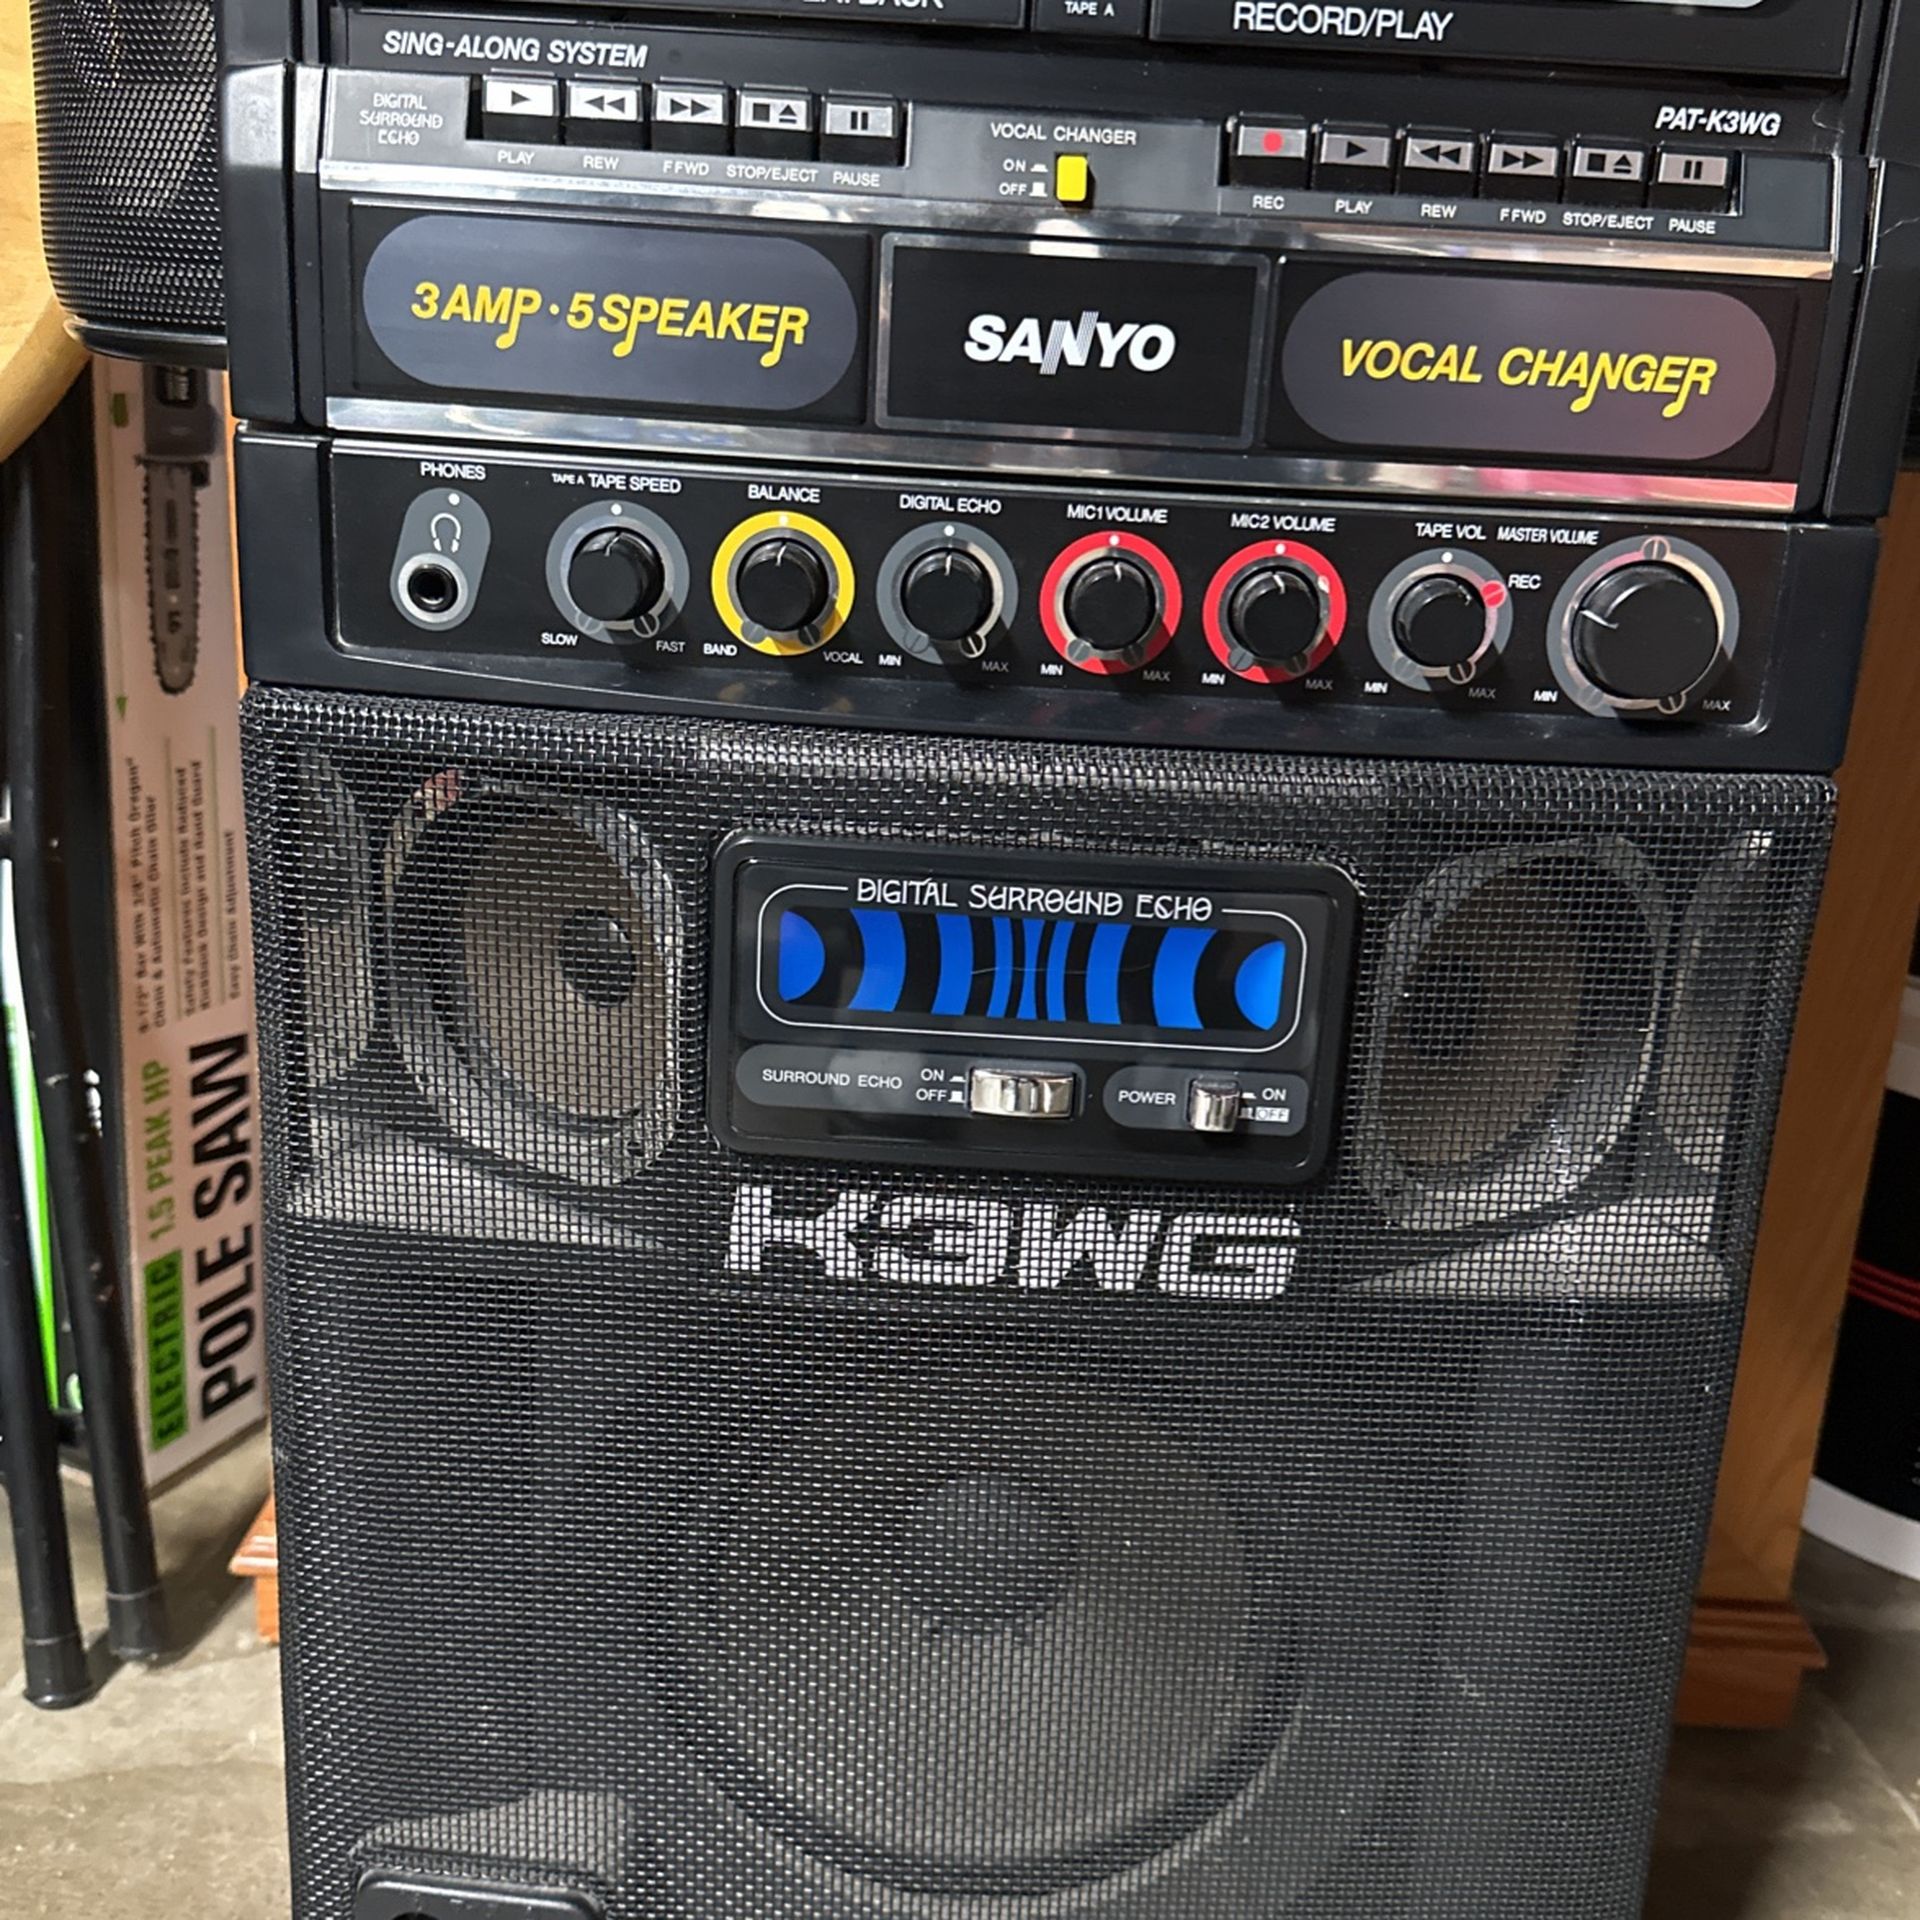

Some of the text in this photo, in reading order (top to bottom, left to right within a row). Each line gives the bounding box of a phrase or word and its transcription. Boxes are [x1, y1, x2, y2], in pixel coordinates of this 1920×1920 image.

[1065, 1, 1116, 16] TAPE A
[1233, 1, 1454, 42] RECORD/PLAY
[382, 31, 647, 68] SING-ALONG SYSTEM
[373, 92, 428, 110] DIGITAL
[360, 110, 443, 129] SURROUND
[1655, 106, 1783, 137] PAT-K3WG
[378, 129, 420, 146] ECHO
[991, 122, 1137, 145] VOCAL CHANGER
[498, 151, 534, 165] PLAY
[583, 156, 619, 171] REW
[1003, 158, 1027, 173] ON
[726, 164, 818, 184] STOP/EJECT
[833, 171, 880, 188] PAUSE
[999, 182, 1028, 197] OFF
[1252, 195, 1284, 211] REC
[1335, 200, 1373, 216] PLAY
[1421, 204, 1456, 219] REW
[1562, 213, 1655, 231] STOP/EJECT
[1669, 218, 1716, 235] PAUSE
[964, 311, 1176, 375] SANYO
[1341, 338, 1718, 419] VOCAL CHANGER
[420, 462, 486, 481] PHONES
[552, 473, 681, 494] TAPE A TAPE SPEED
[748, 485, 820, 503] BALANCE
[900, 494, 1001, 514] DIGITAL ECHO
[1231, 513, 1336, 533] MIC2 VOLUME
[1416, 522, 1487, 541] TAPE VOL
[1497, 527, 1599, 546] MASTER VOLUME
[1508, 574, 1541, 590] REC
[541, 633, 578, 646] SLOW
[656, 640, 686, 653] FAST
[704, 643, 737, 657] BAND
[823, 651, 864, 665] VOCAL
[878, 655, 901, 667] MIN
[982, 660, 1010, 673] MAX
[1040, 664, 1064, 676] MIN
[1143, 670, 1171, 683] MAX
[1202, 673, 1226, 685] MIN
[1306, 679, 1334, 691] MAX
[1364, 681, 1388, 694] MIN
[1468, 687, 1496, 699] MAX
[1533, 690, 1558, 703] MIN
[1702, 699, 1731, 712] MAX
[857, 877, 1213, 922] DIGITAL SURROUND ECHO
[762, 1069, 903, 1089] SURROUND ECHO
[920, 1067, 945, 1082] ON
[915, 1088, 947, 1103] OFF
[1118, 1090, 1176, 1106] POWER
[1262, 1087, 1286, 1101] ON
[1257, 1108, 1288, 1121] OFF
[189, 1033, 256, 1420] POLE SAW
[141, 1060, 184, 1440] ELECTRIC 1.5 PEAK HP
[724, 1184, 1301, 1301] K3WG
